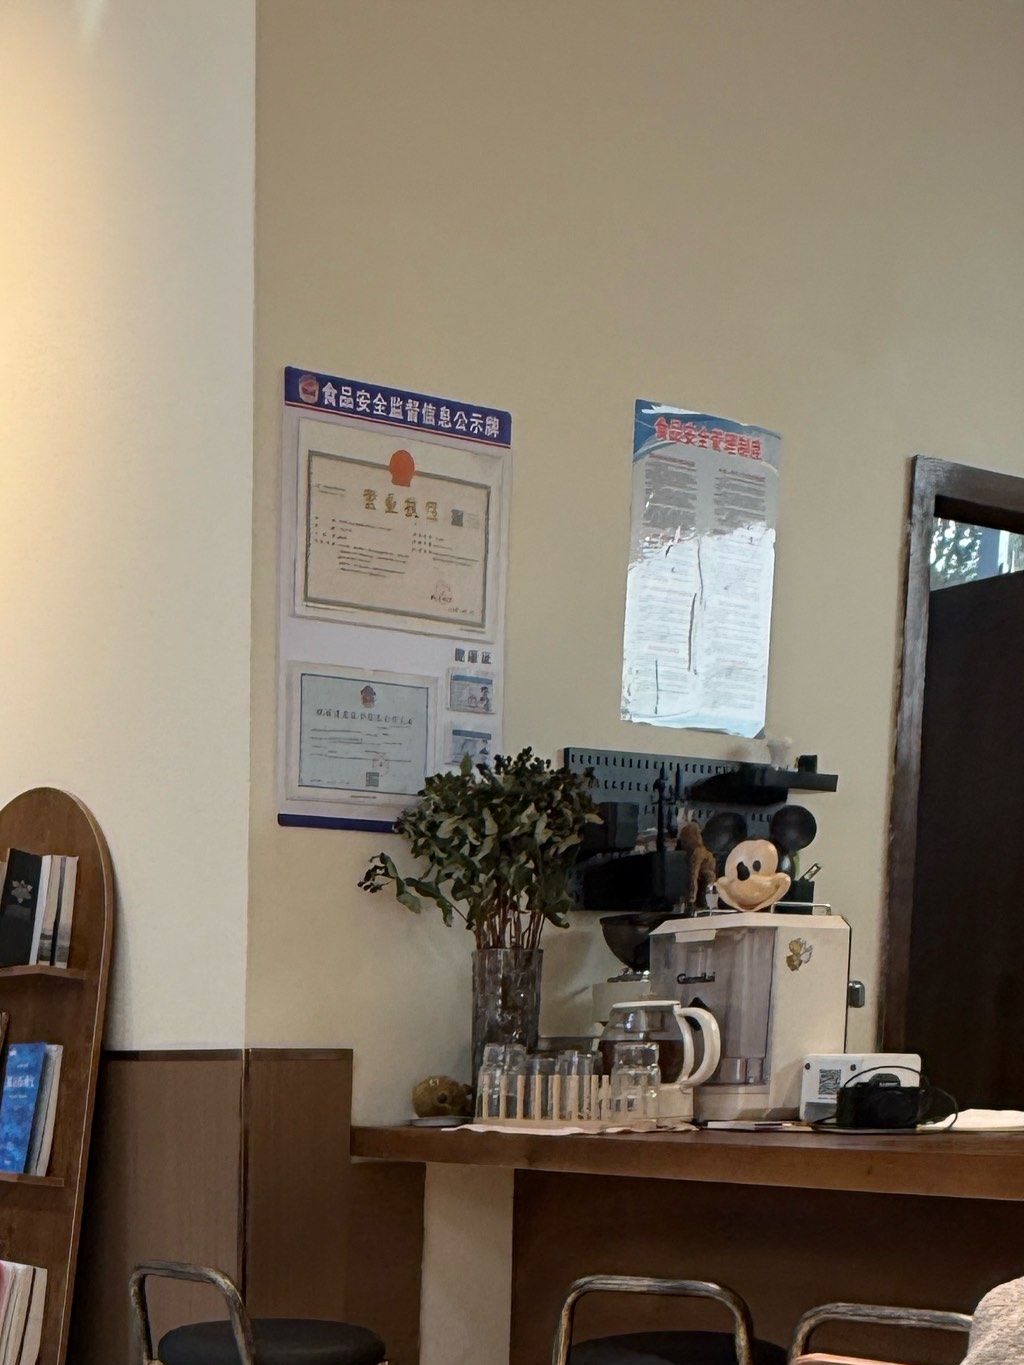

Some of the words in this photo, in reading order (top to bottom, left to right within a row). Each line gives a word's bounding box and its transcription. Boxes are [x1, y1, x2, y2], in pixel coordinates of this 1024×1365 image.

[321, 381, 500, 438] 食品安全监督信息公示牌
